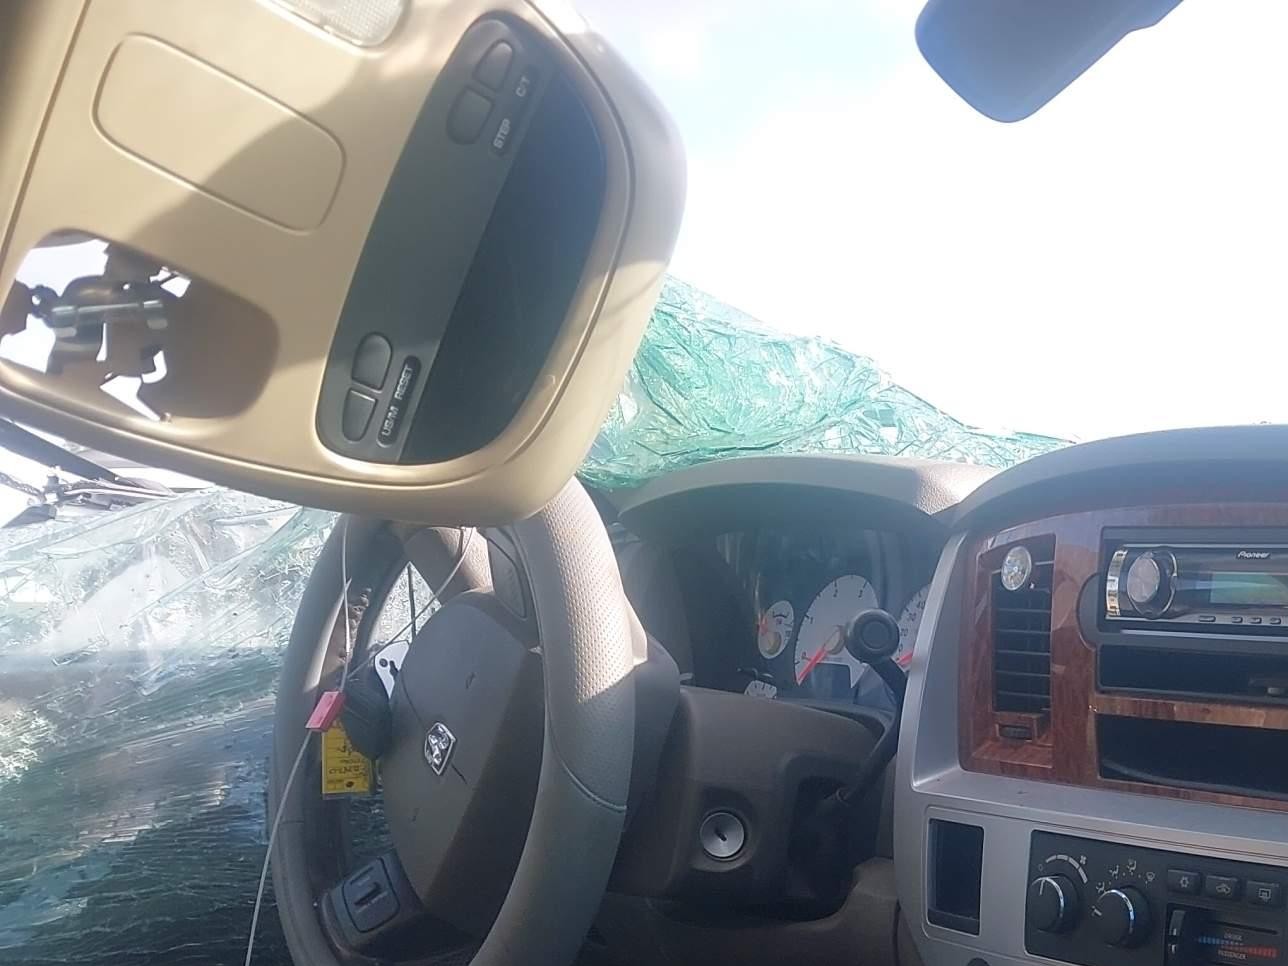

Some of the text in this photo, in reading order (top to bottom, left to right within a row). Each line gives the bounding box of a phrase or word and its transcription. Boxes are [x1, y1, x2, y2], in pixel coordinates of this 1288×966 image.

[493, 118, 511, 149] STEP
[394, 363, 413, 400] RESET
[381, 405, 399, 436] US/M
[1237, 550, 1271, 559] Pioneer
